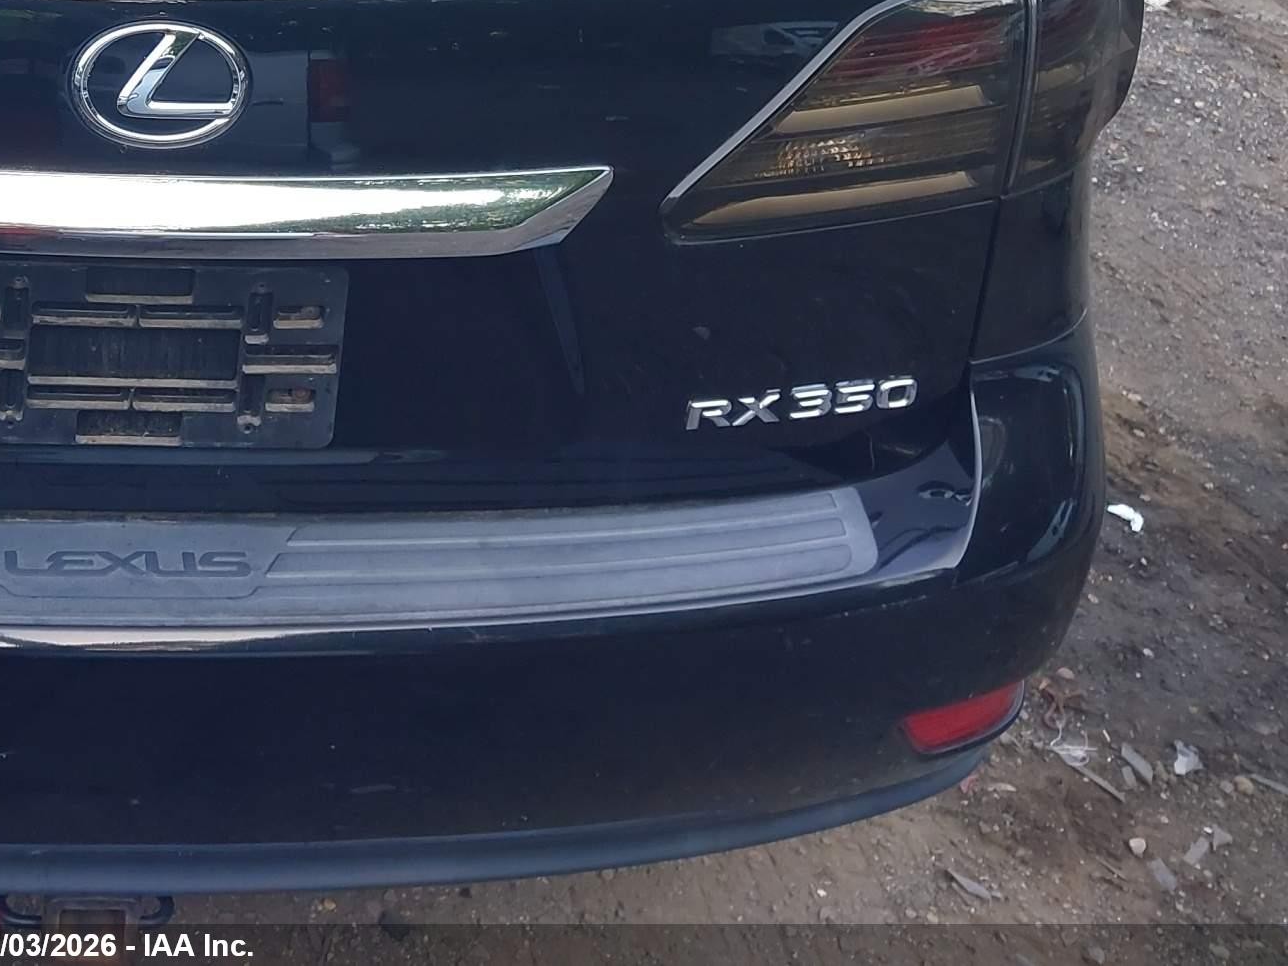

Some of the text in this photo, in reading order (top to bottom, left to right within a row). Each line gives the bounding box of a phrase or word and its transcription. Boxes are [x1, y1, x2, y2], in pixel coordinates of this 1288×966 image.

[685, 375, 918, 430] RX 350
[4, 550, 252, 577] LEXUS
